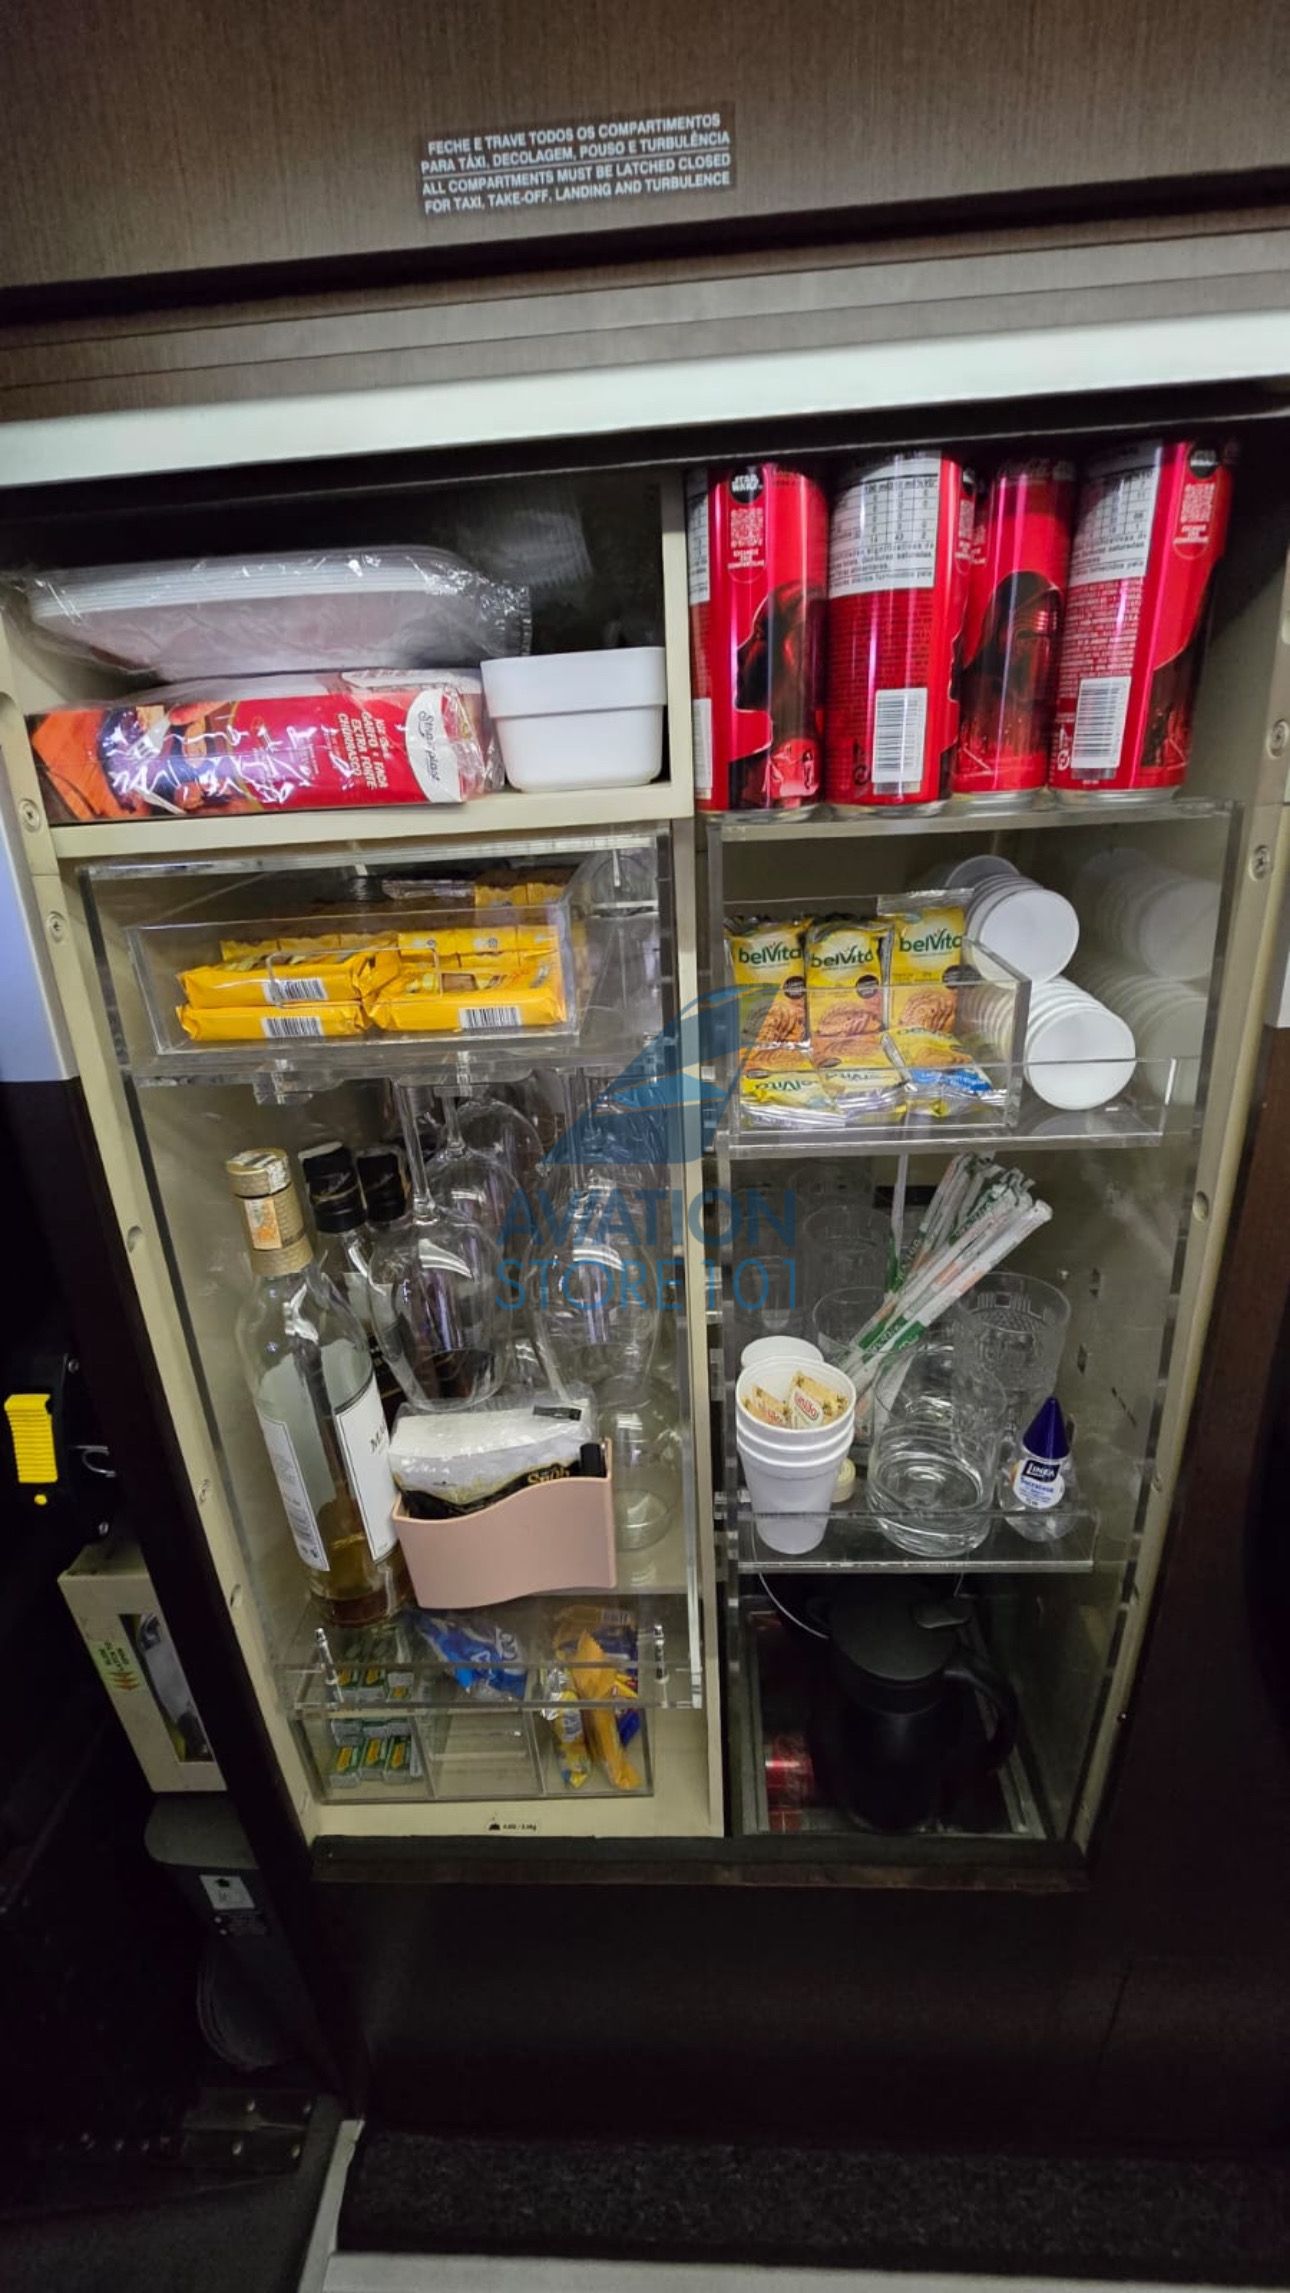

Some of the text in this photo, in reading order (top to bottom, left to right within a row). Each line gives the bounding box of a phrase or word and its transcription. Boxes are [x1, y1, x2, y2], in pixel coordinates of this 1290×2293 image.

[421, 158, 455, 174] PARA
[580, 143, 624, 159] POUSO
[629, 141, 637, 154] E
[640, 131, 730, 152] TURBULÊNCIA
[428, 113, 720, 155] FECHE E TRAVE TODOS OS COMPARTIMENTOS
[422, 153, 730, 196] ALL COMPARTMENTS MUST BE LATCHED CLOSED
[425, 197, 451, 214] FOR
[556, 181, 611, 201] LANDING
[615, 179, 642, 194] AND
[645, 172, 730, 192] TURBULENCE
[738, 942, 802, 965] belVita
[809, 945, 874, 968] belVita
[899, 928, 962, 953] belVita
